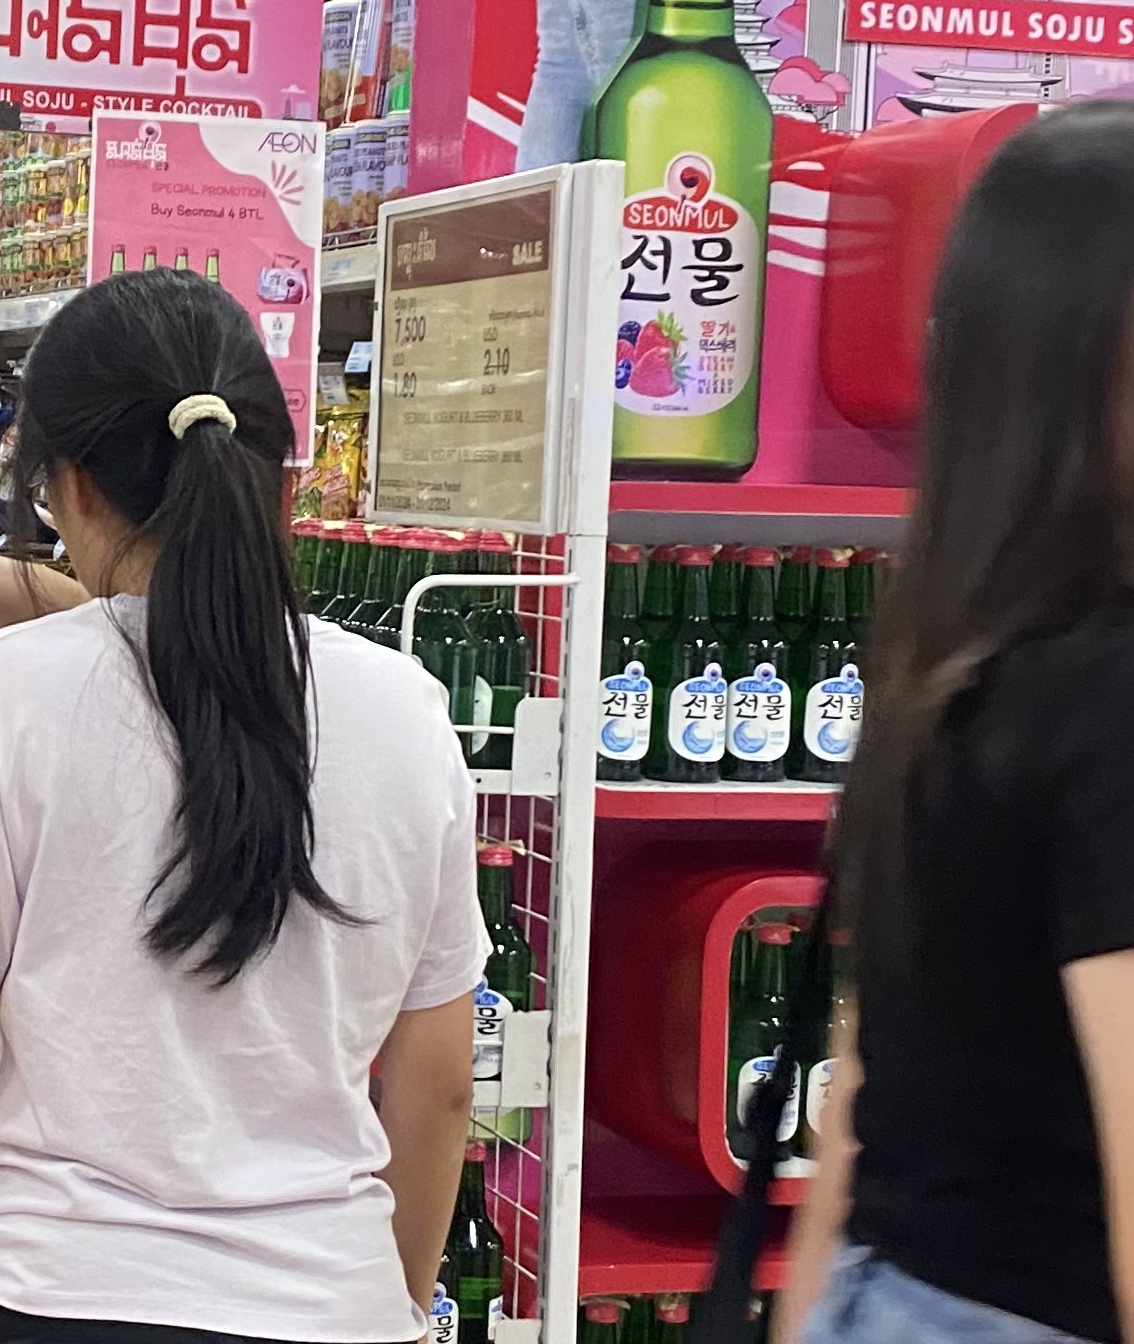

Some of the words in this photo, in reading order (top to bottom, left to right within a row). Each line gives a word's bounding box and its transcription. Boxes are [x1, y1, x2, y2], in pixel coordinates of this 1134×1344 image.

[860, 1, 1014, 37] SEONMUL
[1028, 13, 1104, 43] SOJU
[23, 91, 74, 110] SOJU
[94, 95, 152, 113] STYLE
[151, 181, 198, 195] SPECIAL
[202, 185, 266, 198] PROMOTION
[151, 204, 173, 218] Buy
[228, 209, 235, 219] 4
[239, 208, 264, 220] BTL
[628, 204, 729, 229] SEONMUL
[512, 240, 544, 266] SALE
